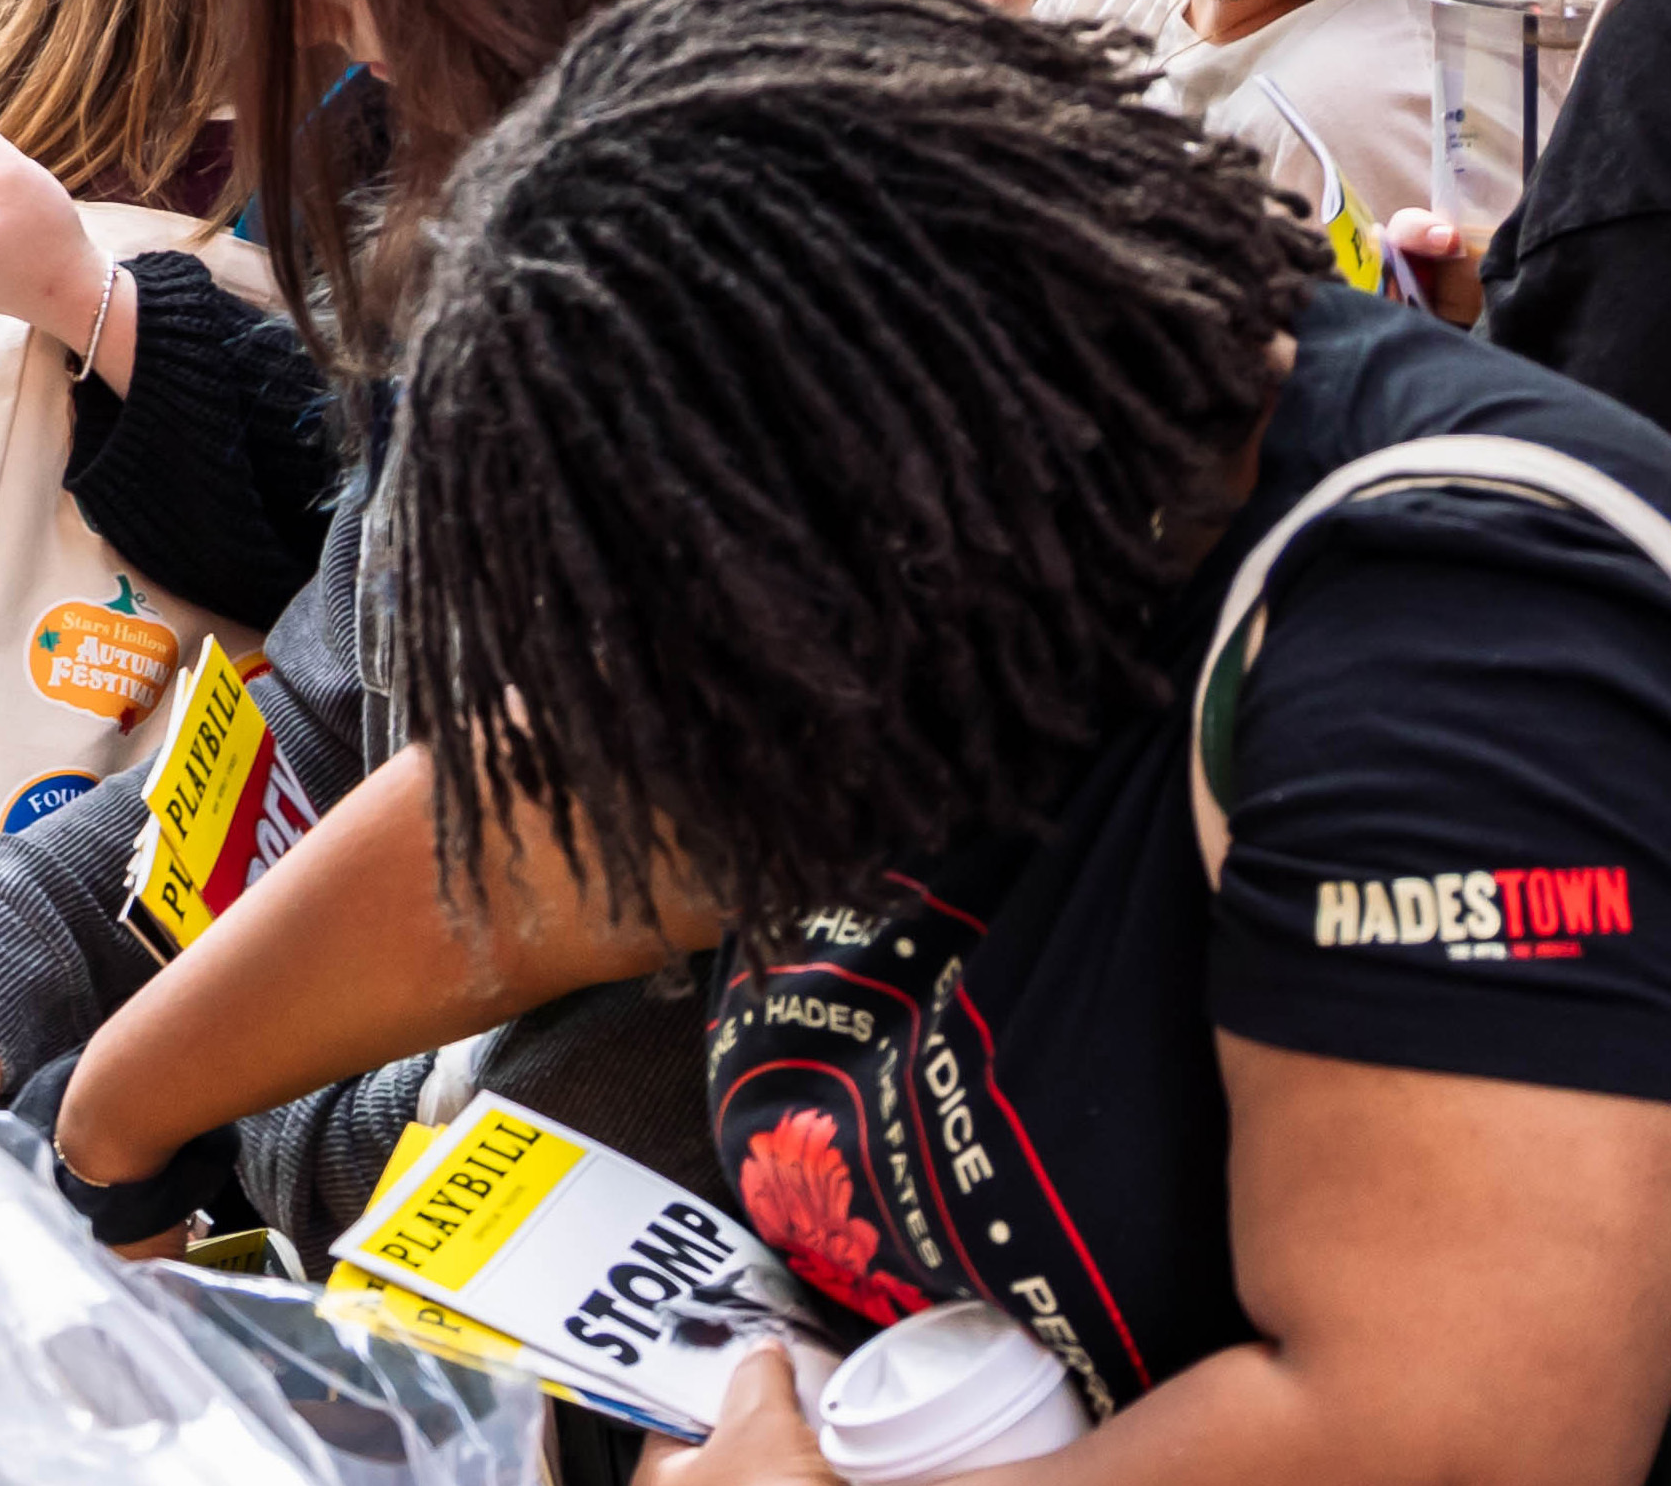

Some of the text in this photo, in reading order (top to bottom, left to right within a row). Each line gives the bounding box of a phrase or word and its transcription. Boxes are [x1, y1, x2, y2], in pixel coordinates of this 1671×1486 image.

[61, 611, 168, 656] Stars Hollow
[165, 669, 243, 841] PLAYBILL
[1314, 866, 1634, 948] HADESTOWN
[764, 994, 875, 1043] HADES
[378, 1121, 544, 1271] PLAYBILL
[882, 1119, 943, 1270] FATES
[563, 1201, 738, 1367] STOMP
